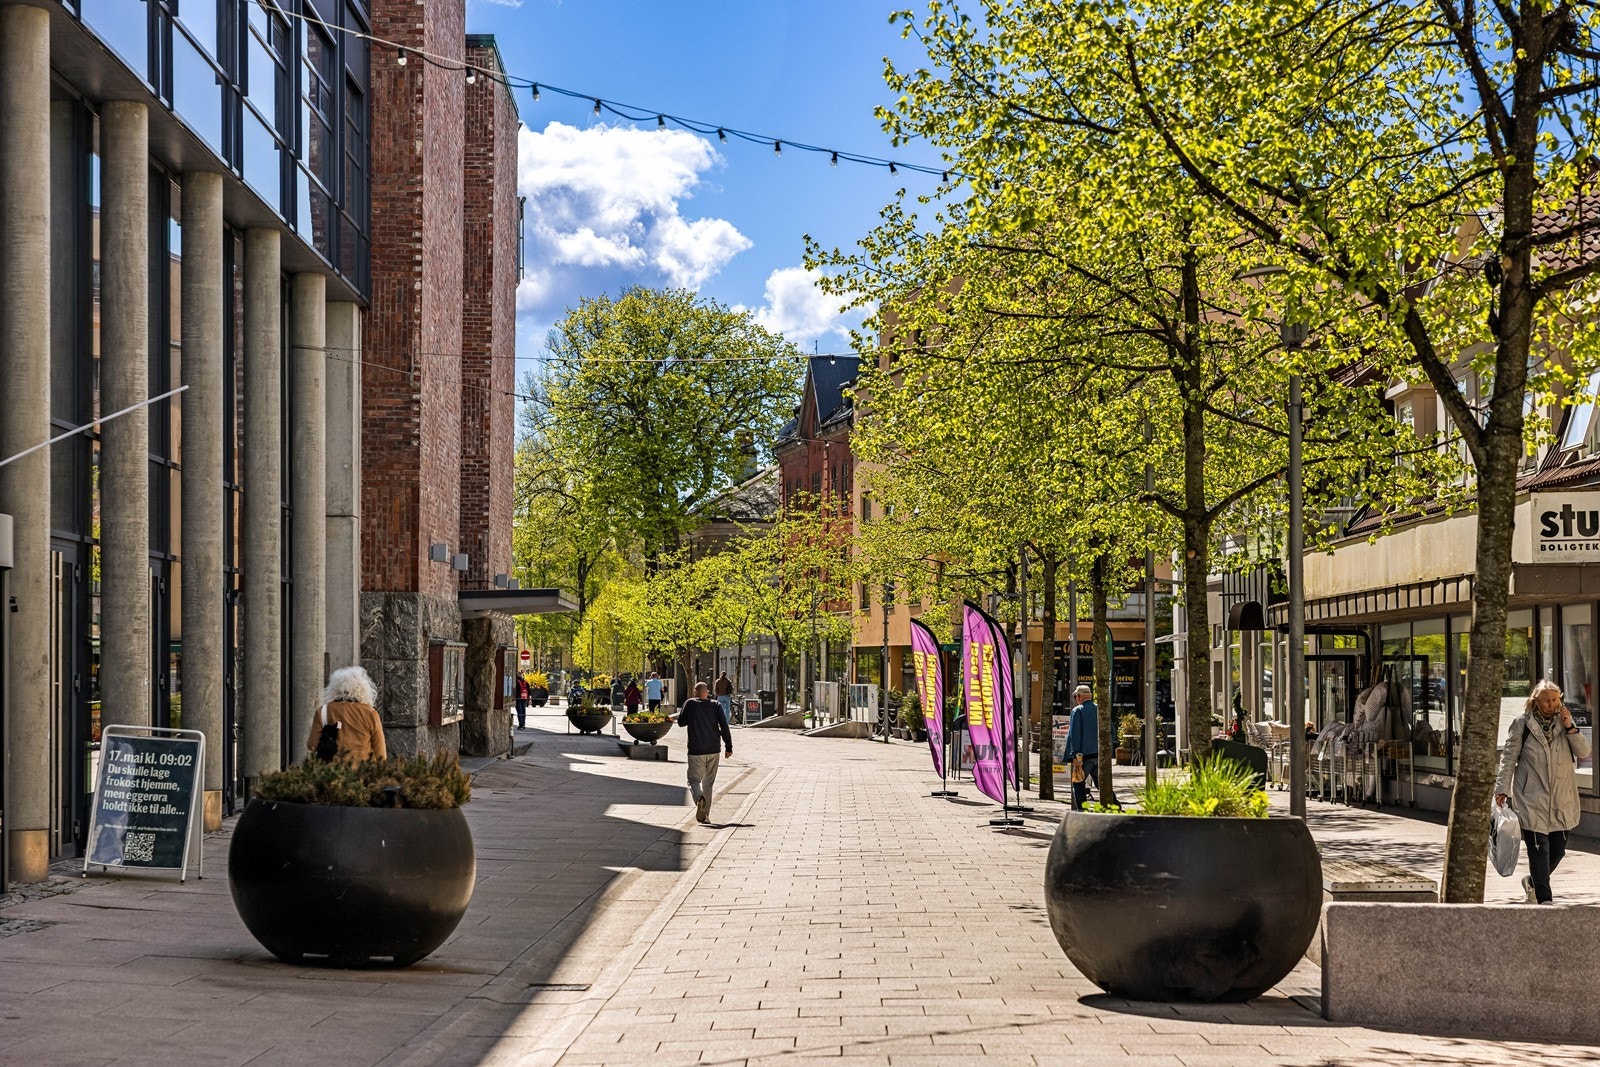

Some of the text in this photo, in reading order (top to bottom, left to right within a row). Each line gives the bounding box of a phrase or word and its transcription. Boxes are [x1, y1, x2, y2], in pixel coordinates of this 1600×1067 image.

[1063, 643, 1095, 654] CTUS
[145, 752, 157, 764] kl.
[160, 753, 192, 766] 09:02
[108, 763, 170, 779] Du skulle lage
[106, 776, 180, 792] frokost hjemme,
[104, 790, 167, 803] men eggerøra
[102, 800, 185, 815] holdt ikke til alle...
